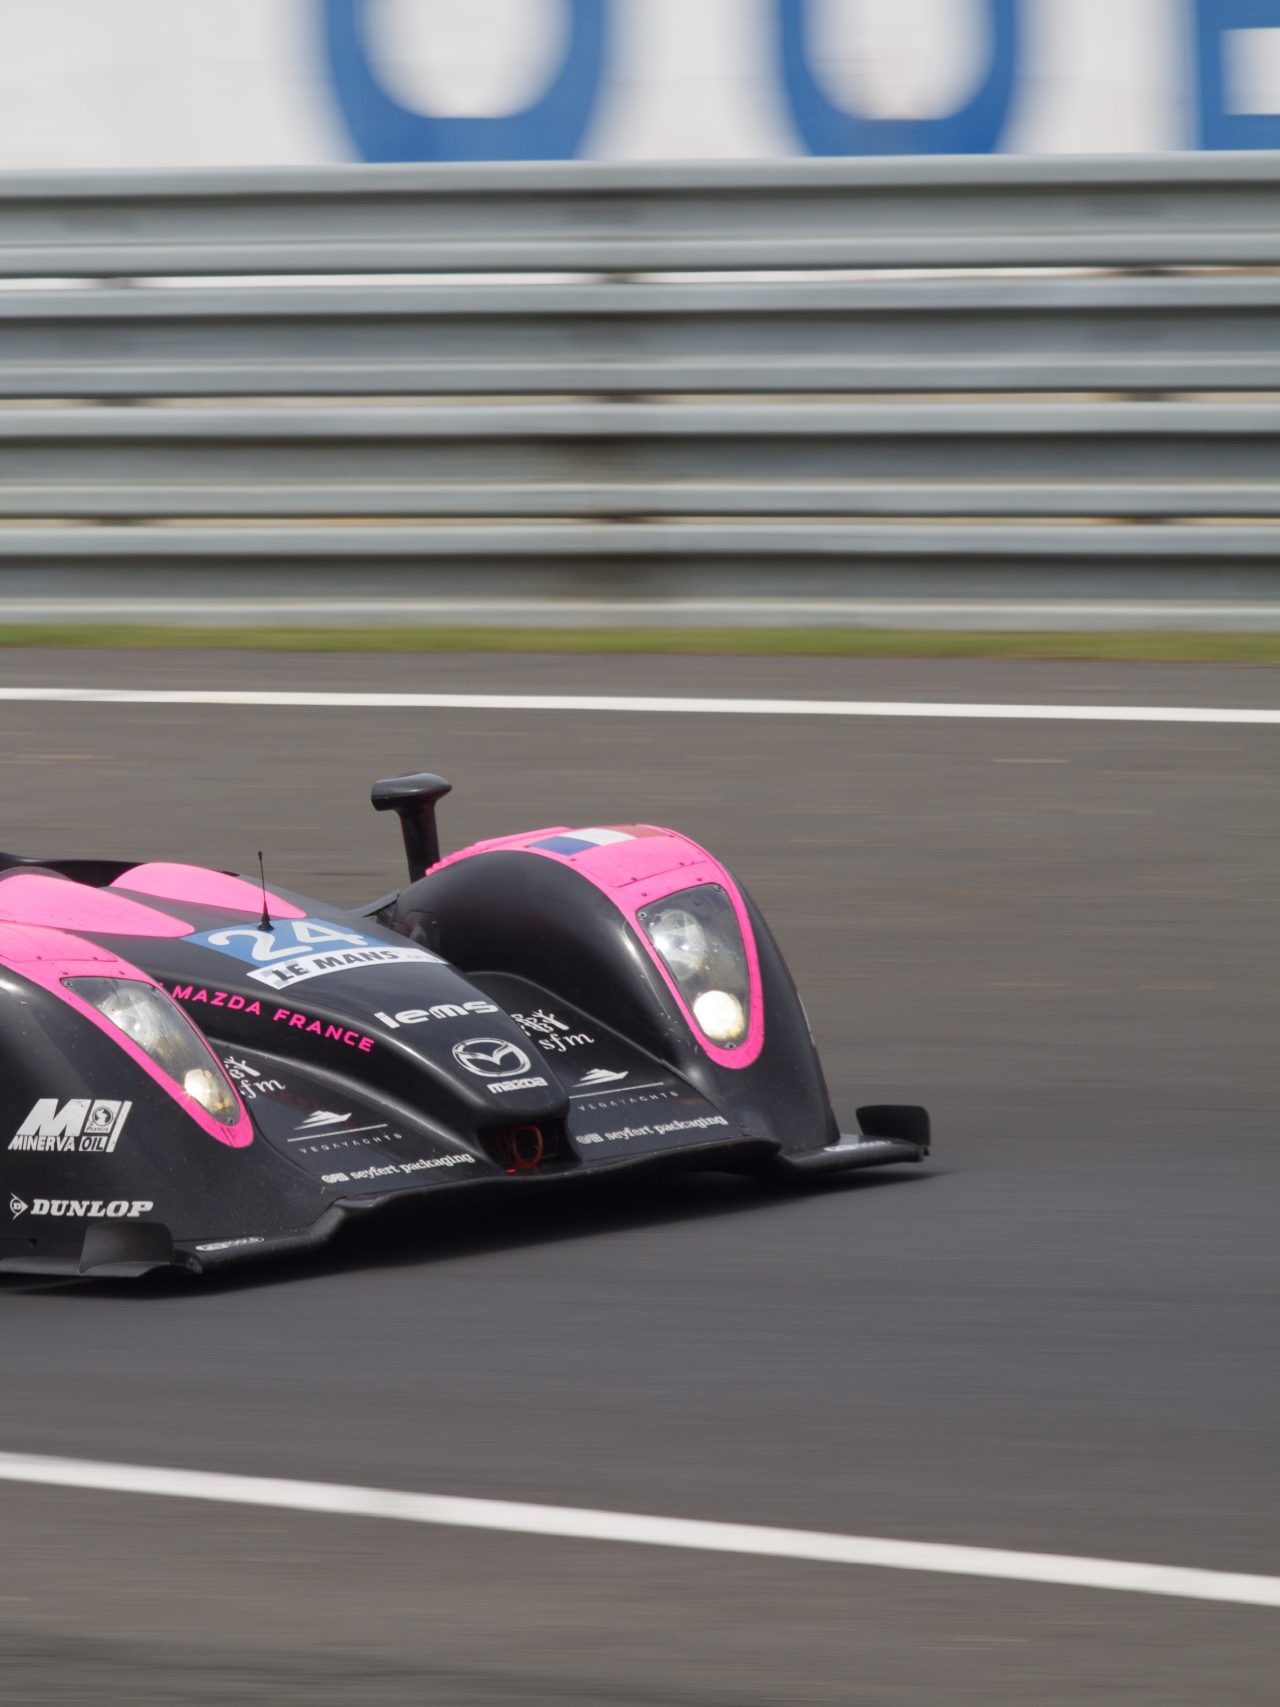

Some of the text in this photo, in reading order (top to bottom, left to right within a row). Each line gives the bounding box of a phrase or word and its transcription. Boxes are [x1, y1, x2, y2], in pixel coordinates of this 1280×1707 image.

[208, 921, 369, 961] 24
[272, 962, 307, 982] LE
[319, 949, 400, 971] MANS
[171, 984, 376, 1053] MAZDA FRANCE
[239, 1077, 286, 1100] fm
[604, 1114, 729, 1141] seyfert packaging
[7, 1135, 104, 1152] MINERVA OIL
[350, 1153, 475, 1182] seyfert packaging
[30, 1198, 154, 1218] DUNLOP
